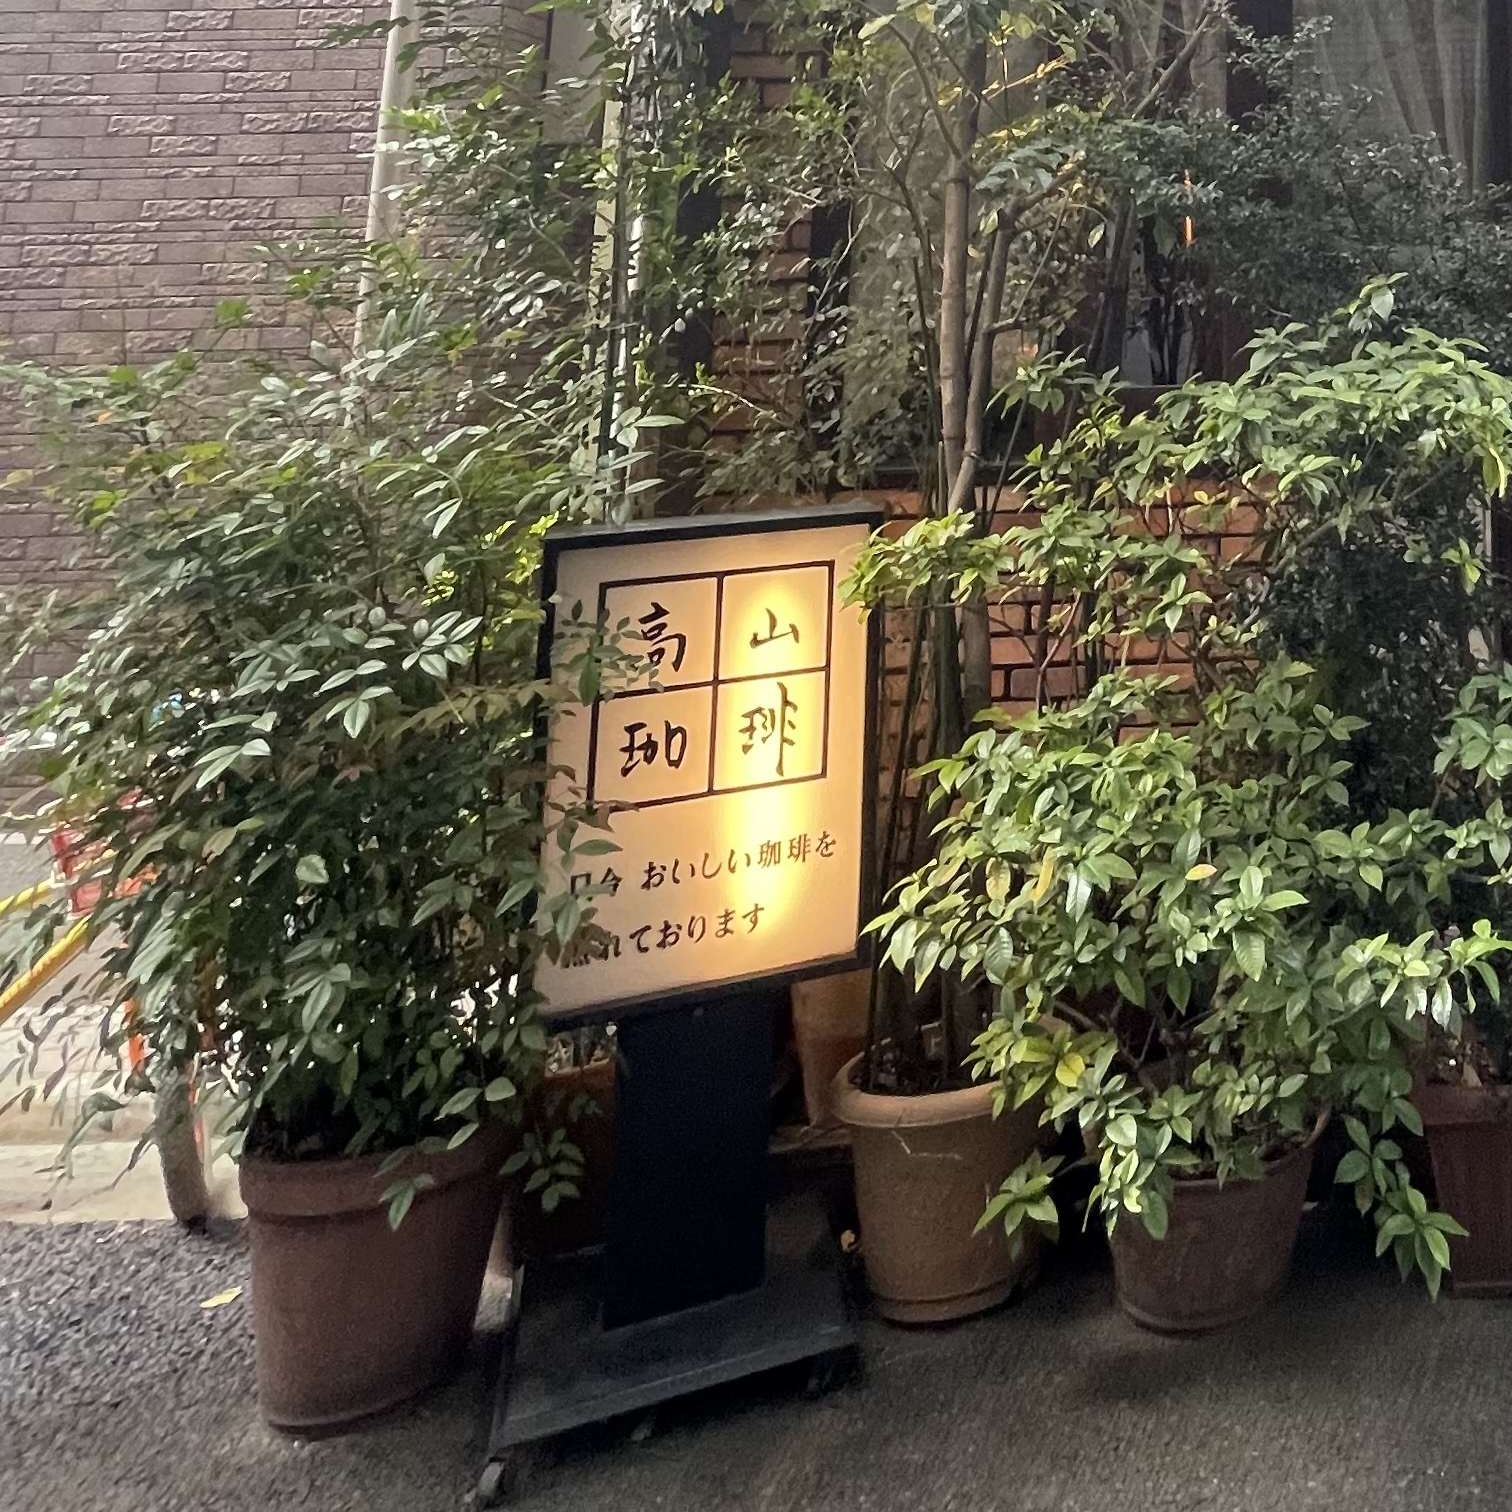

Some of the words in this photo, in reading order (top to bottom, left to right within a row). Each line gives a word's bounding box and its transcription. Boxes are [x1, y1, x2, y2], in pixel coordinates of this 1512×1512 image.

[638, 602, 800, 673] 高山
[619, 682, 798, 778] 珈琲
[641, 830, 838, 891] おいしい珈琲を
